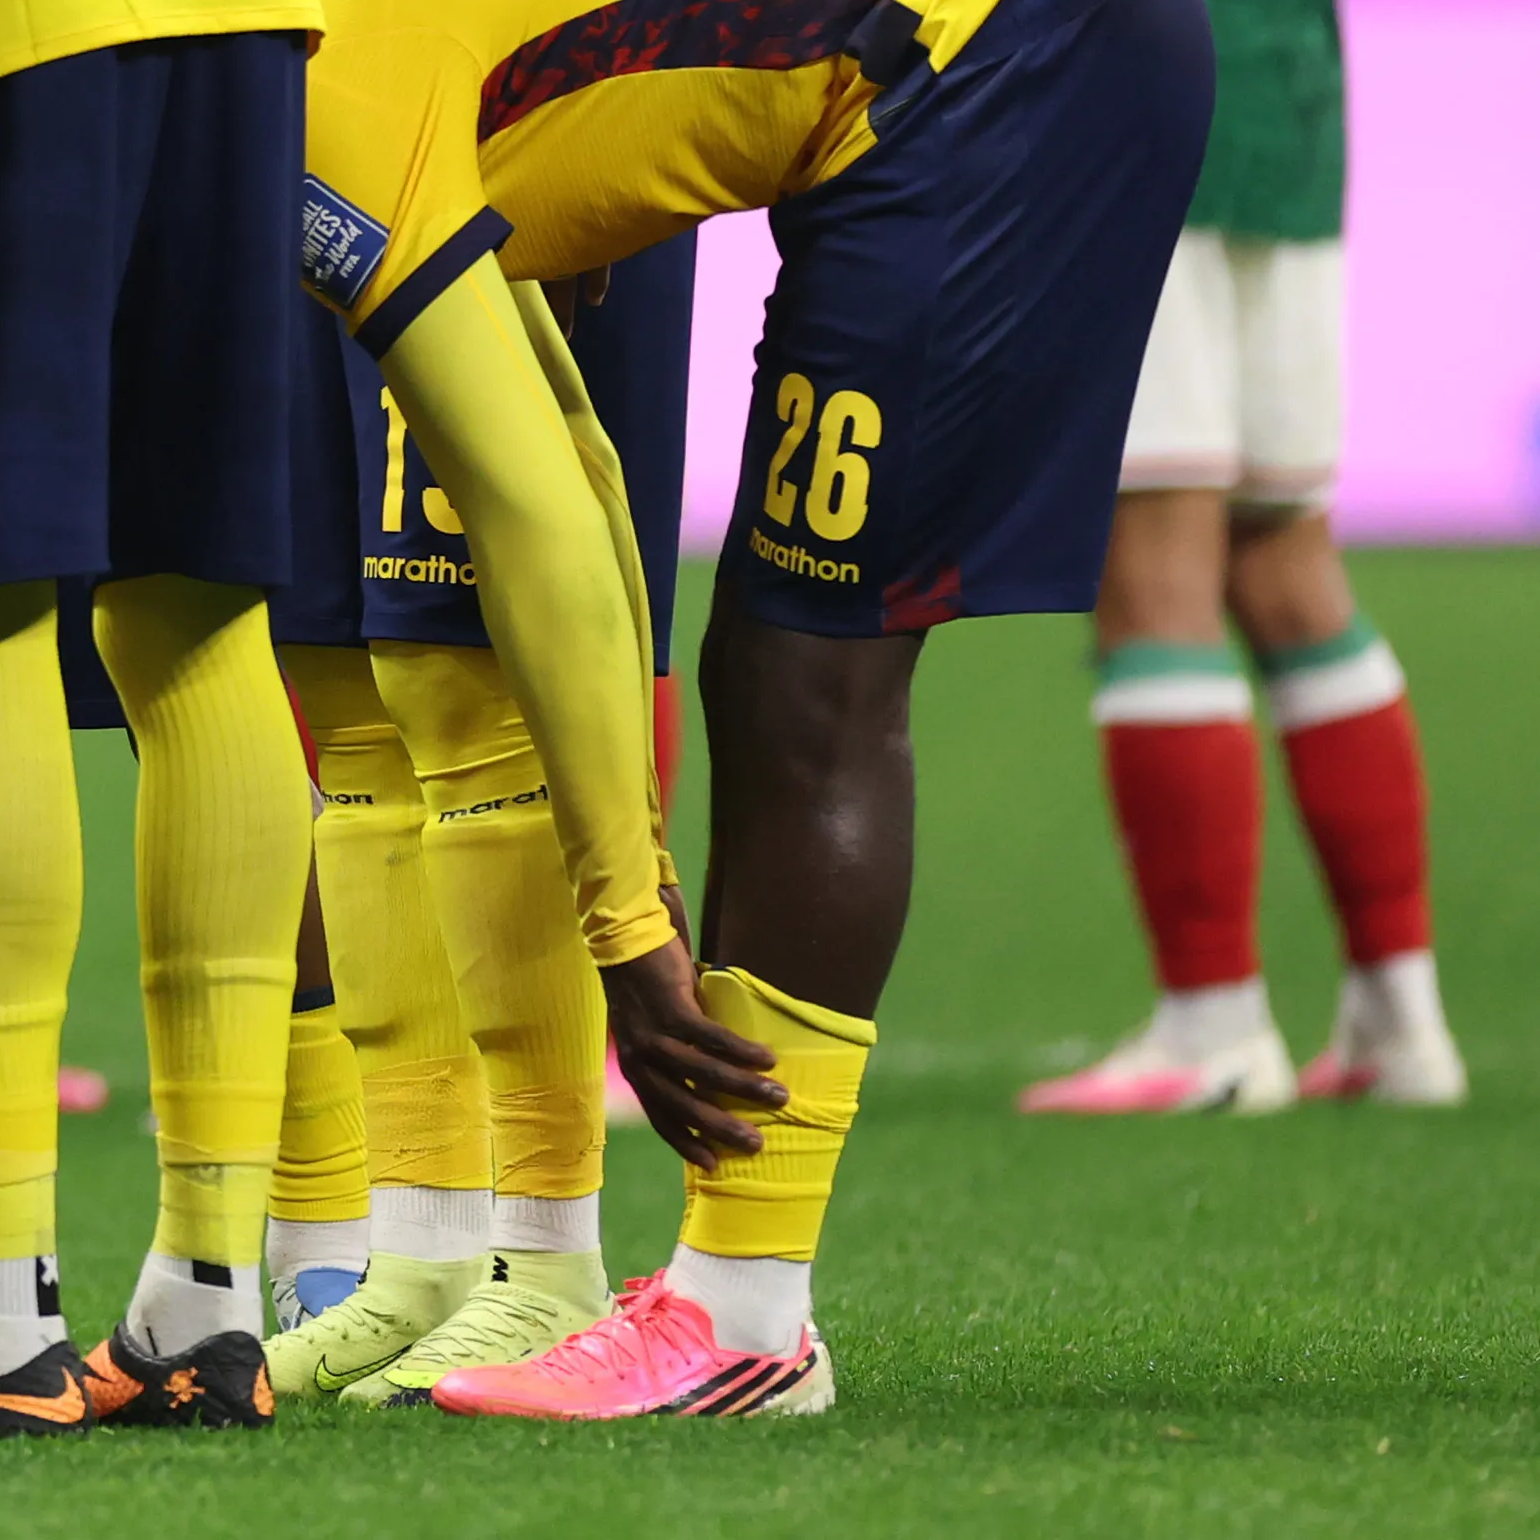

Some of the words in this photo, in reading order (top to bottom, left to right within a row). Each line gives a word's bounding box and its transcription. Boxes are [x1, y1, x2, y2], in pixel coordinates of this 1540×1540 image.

[339, 254, 362, 279] FIFA
[762, 371, 883, 542] 26
[363, 554, 478, 586] maratho
[748, 526, 861, 584] marathon
